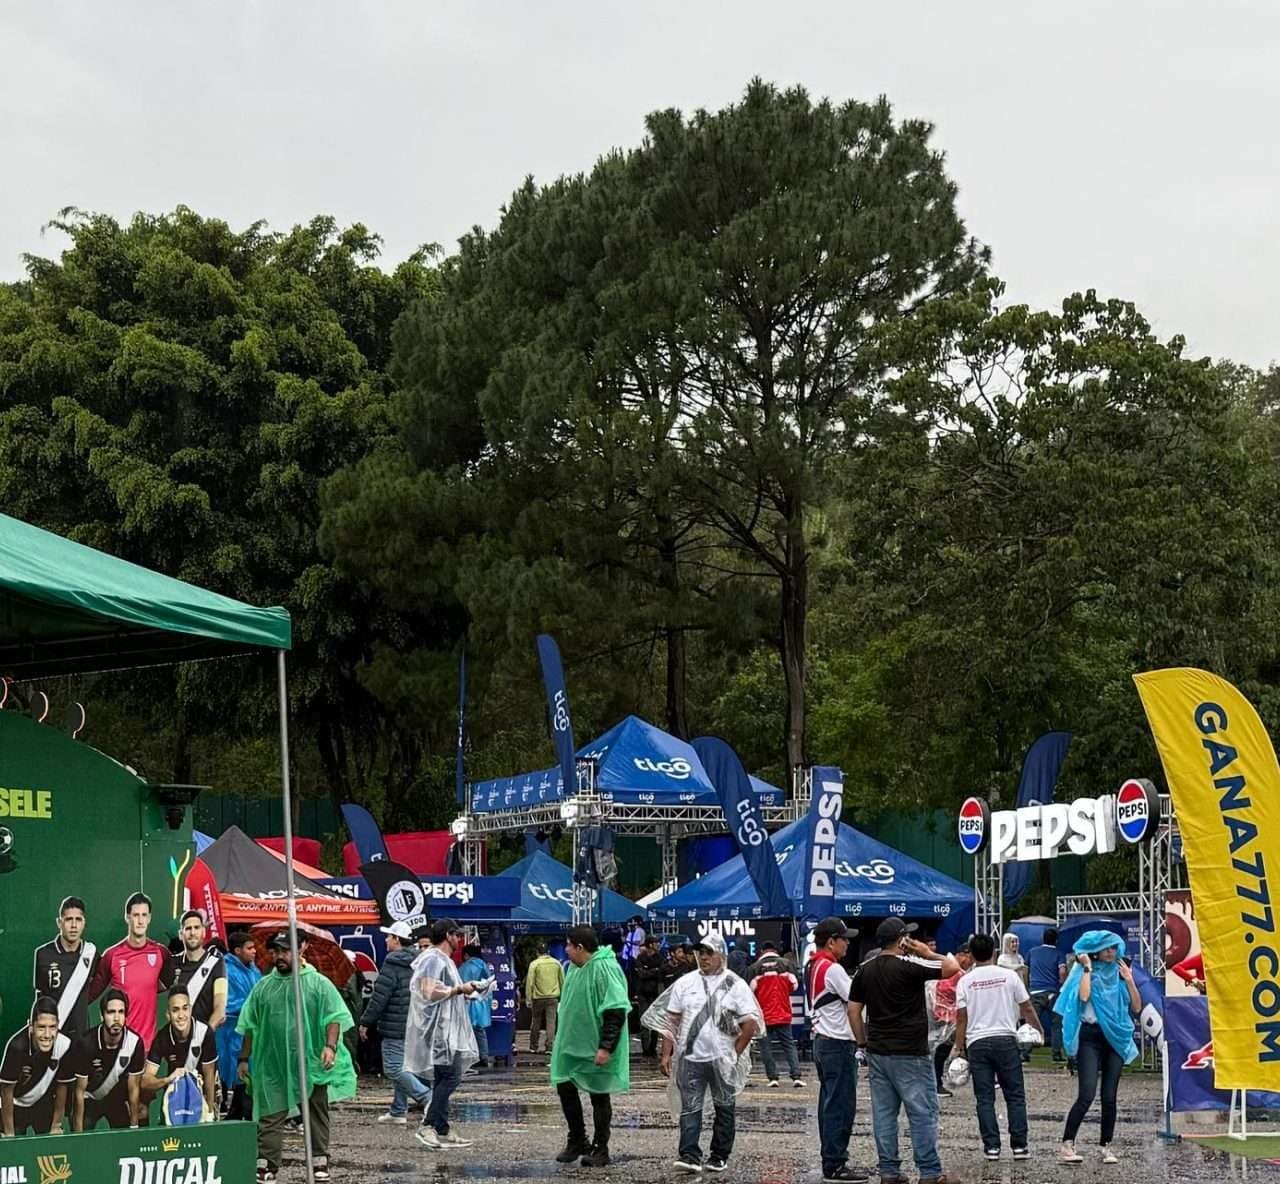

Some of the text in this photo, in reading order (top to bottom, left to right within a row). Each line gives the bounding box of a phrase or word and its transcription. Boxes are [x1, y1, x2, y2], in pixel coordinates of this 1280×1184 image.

[553, 690, 570, 732] tigo
[634, 757, 692, 779] tigo
[1119, 801, 1148, 820] PEPSI
[736, 798, 769, 847] tigo
[960, 819, 983, 832] PEPSI
[991, 794, 1116, 864] PEPSI
[811, 780, 844, 897] PEPSI
[835, 859, 896, 884] tigo
[421, 883, 474, 900] PEPSI
[48, 970, 62, 988] 13
